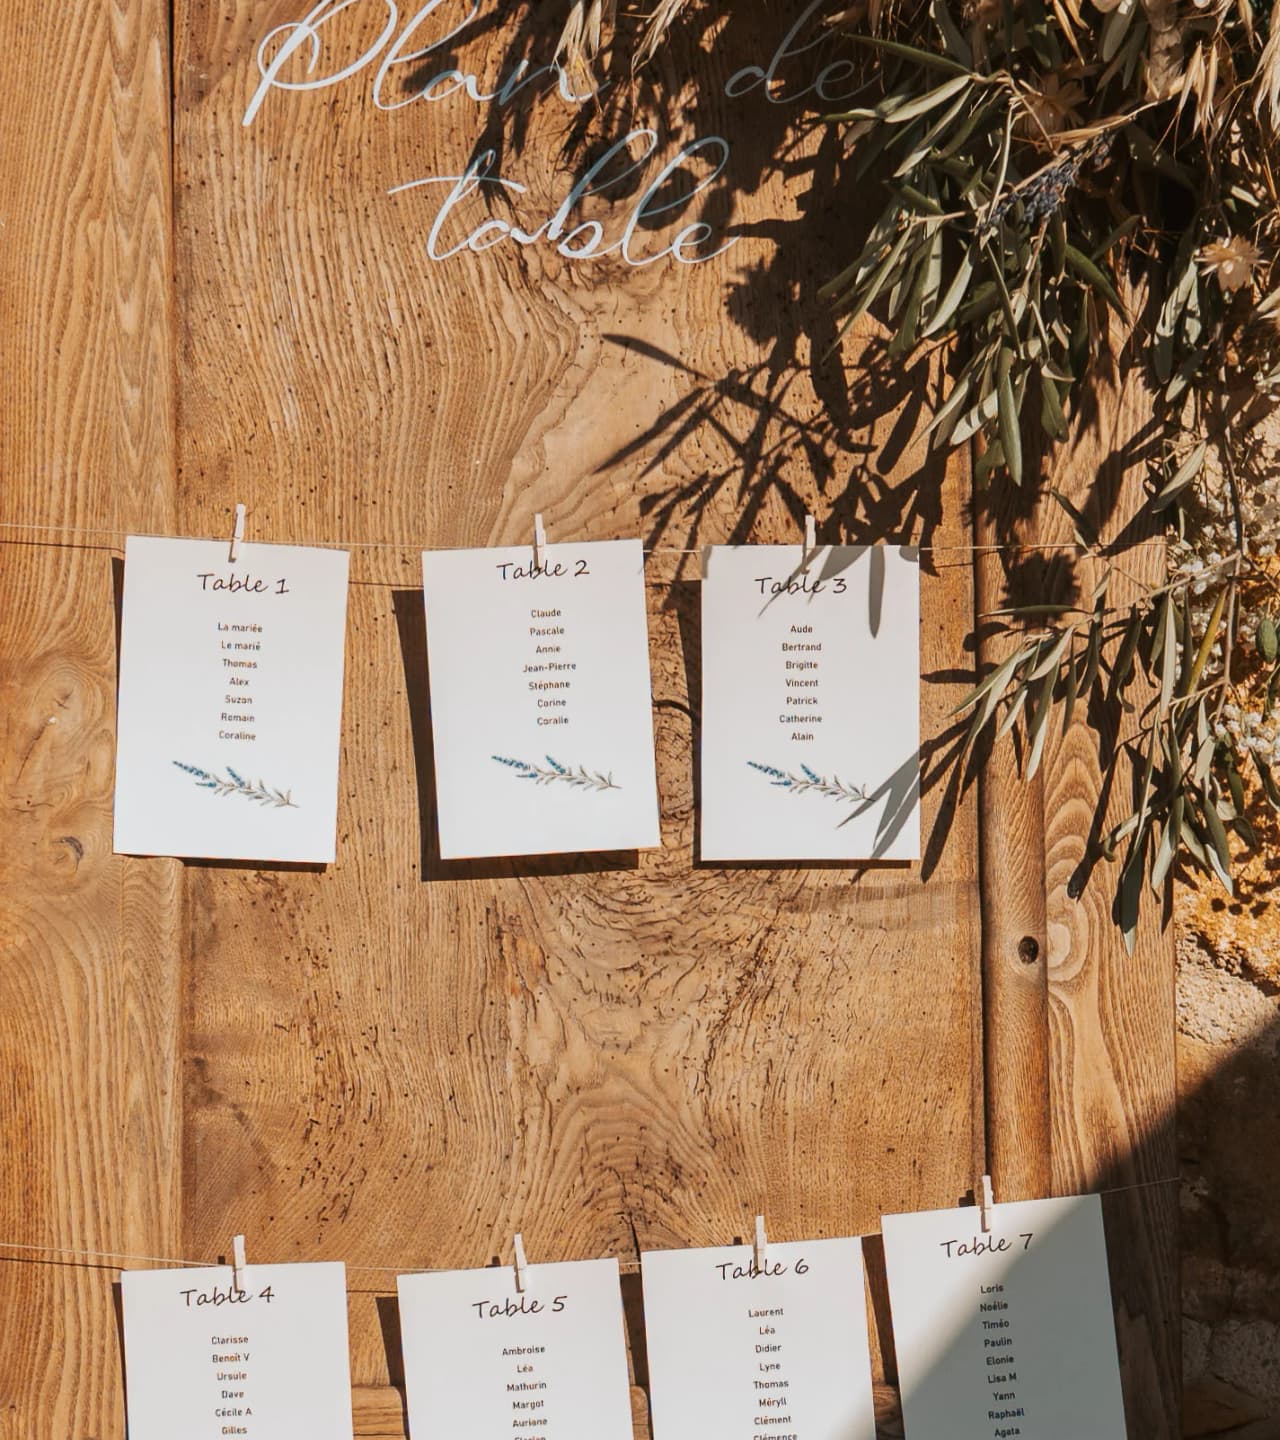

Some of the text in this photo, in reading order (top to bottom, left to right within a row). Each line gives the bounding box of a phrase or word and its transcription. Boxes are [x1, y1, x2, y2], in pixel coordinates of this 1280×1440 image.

[387, 129, 741, 265] table
[495, 559, 591, 581] Table 2
[196, 572, 290, 595] Table 1
[753, 574, 848, 596] Table 3
[530, 607, 562, 619] Claude
[217, 621, 263, 633] La mariée
[529, 625, 565, 637] Pascale
[790, 624, 813, 634] Aude
[221, 639, 261, 651] Le marié
[535, 644, 561, 654] Annie
[781, 642, 822, 652] Bertrand
[222, 657, 258, 670] Thomas
[522, 662, 577, 673] Jean-Pierre
[785, 660, 819, 672] Brigitte
[228, 676, 250, 687] Alex
[528, 680, 571, 692] Stéphane
[785, 678, 819, 688] Vincent
[786, 696, 818, 706] Patrick
[220, 711, 255, 723] Romain
[778, 714, 823, 724] Catherine
[218, 729, 257, 742] Coraline
[791, 731, 814, 742] Alain
[939, 1232, 1035, 1259] Table 7
[714, 1257, 810, 1281] Table 6
[980, 1283, 1005, 1296] Loris
[179, 1285, 276, 1307] Table 4
[471, 1295, 568, 1319] Table 5
[747, 1307, 784, 1319] Laurent
[759, 1324, 776, 1336] Léa
[981, 1318, 1010, 1330] Timéo
[211, 1335, 249, 1345] Clarisse
[983, 1336, 1013, 1349] Paulin
[502, 1345, 546, 1356] Ambroise
[754, 1343, 782, 1354] Didier
[243, 1352, 251, 1362] V
[516, 1364, 534, 1374] Léa
[987, 1371, 1017, 1385] Lisa M
[506, 1382, 547, 1392] Mathurin
[752, 1380, 790, 1390] Thomas
[221, 1389, 245, 1400] Dave
[992, 1391, 1016, 1401] Yann
[512, 1399, 545, 1411] Margot
[214, 1407, 253, 1418] Cécile A
[753, 1415, 792, 1426] Clément
[221, 1425, 248, 1436] Gilles
[994, 1426, 1021, 1439] Agata
